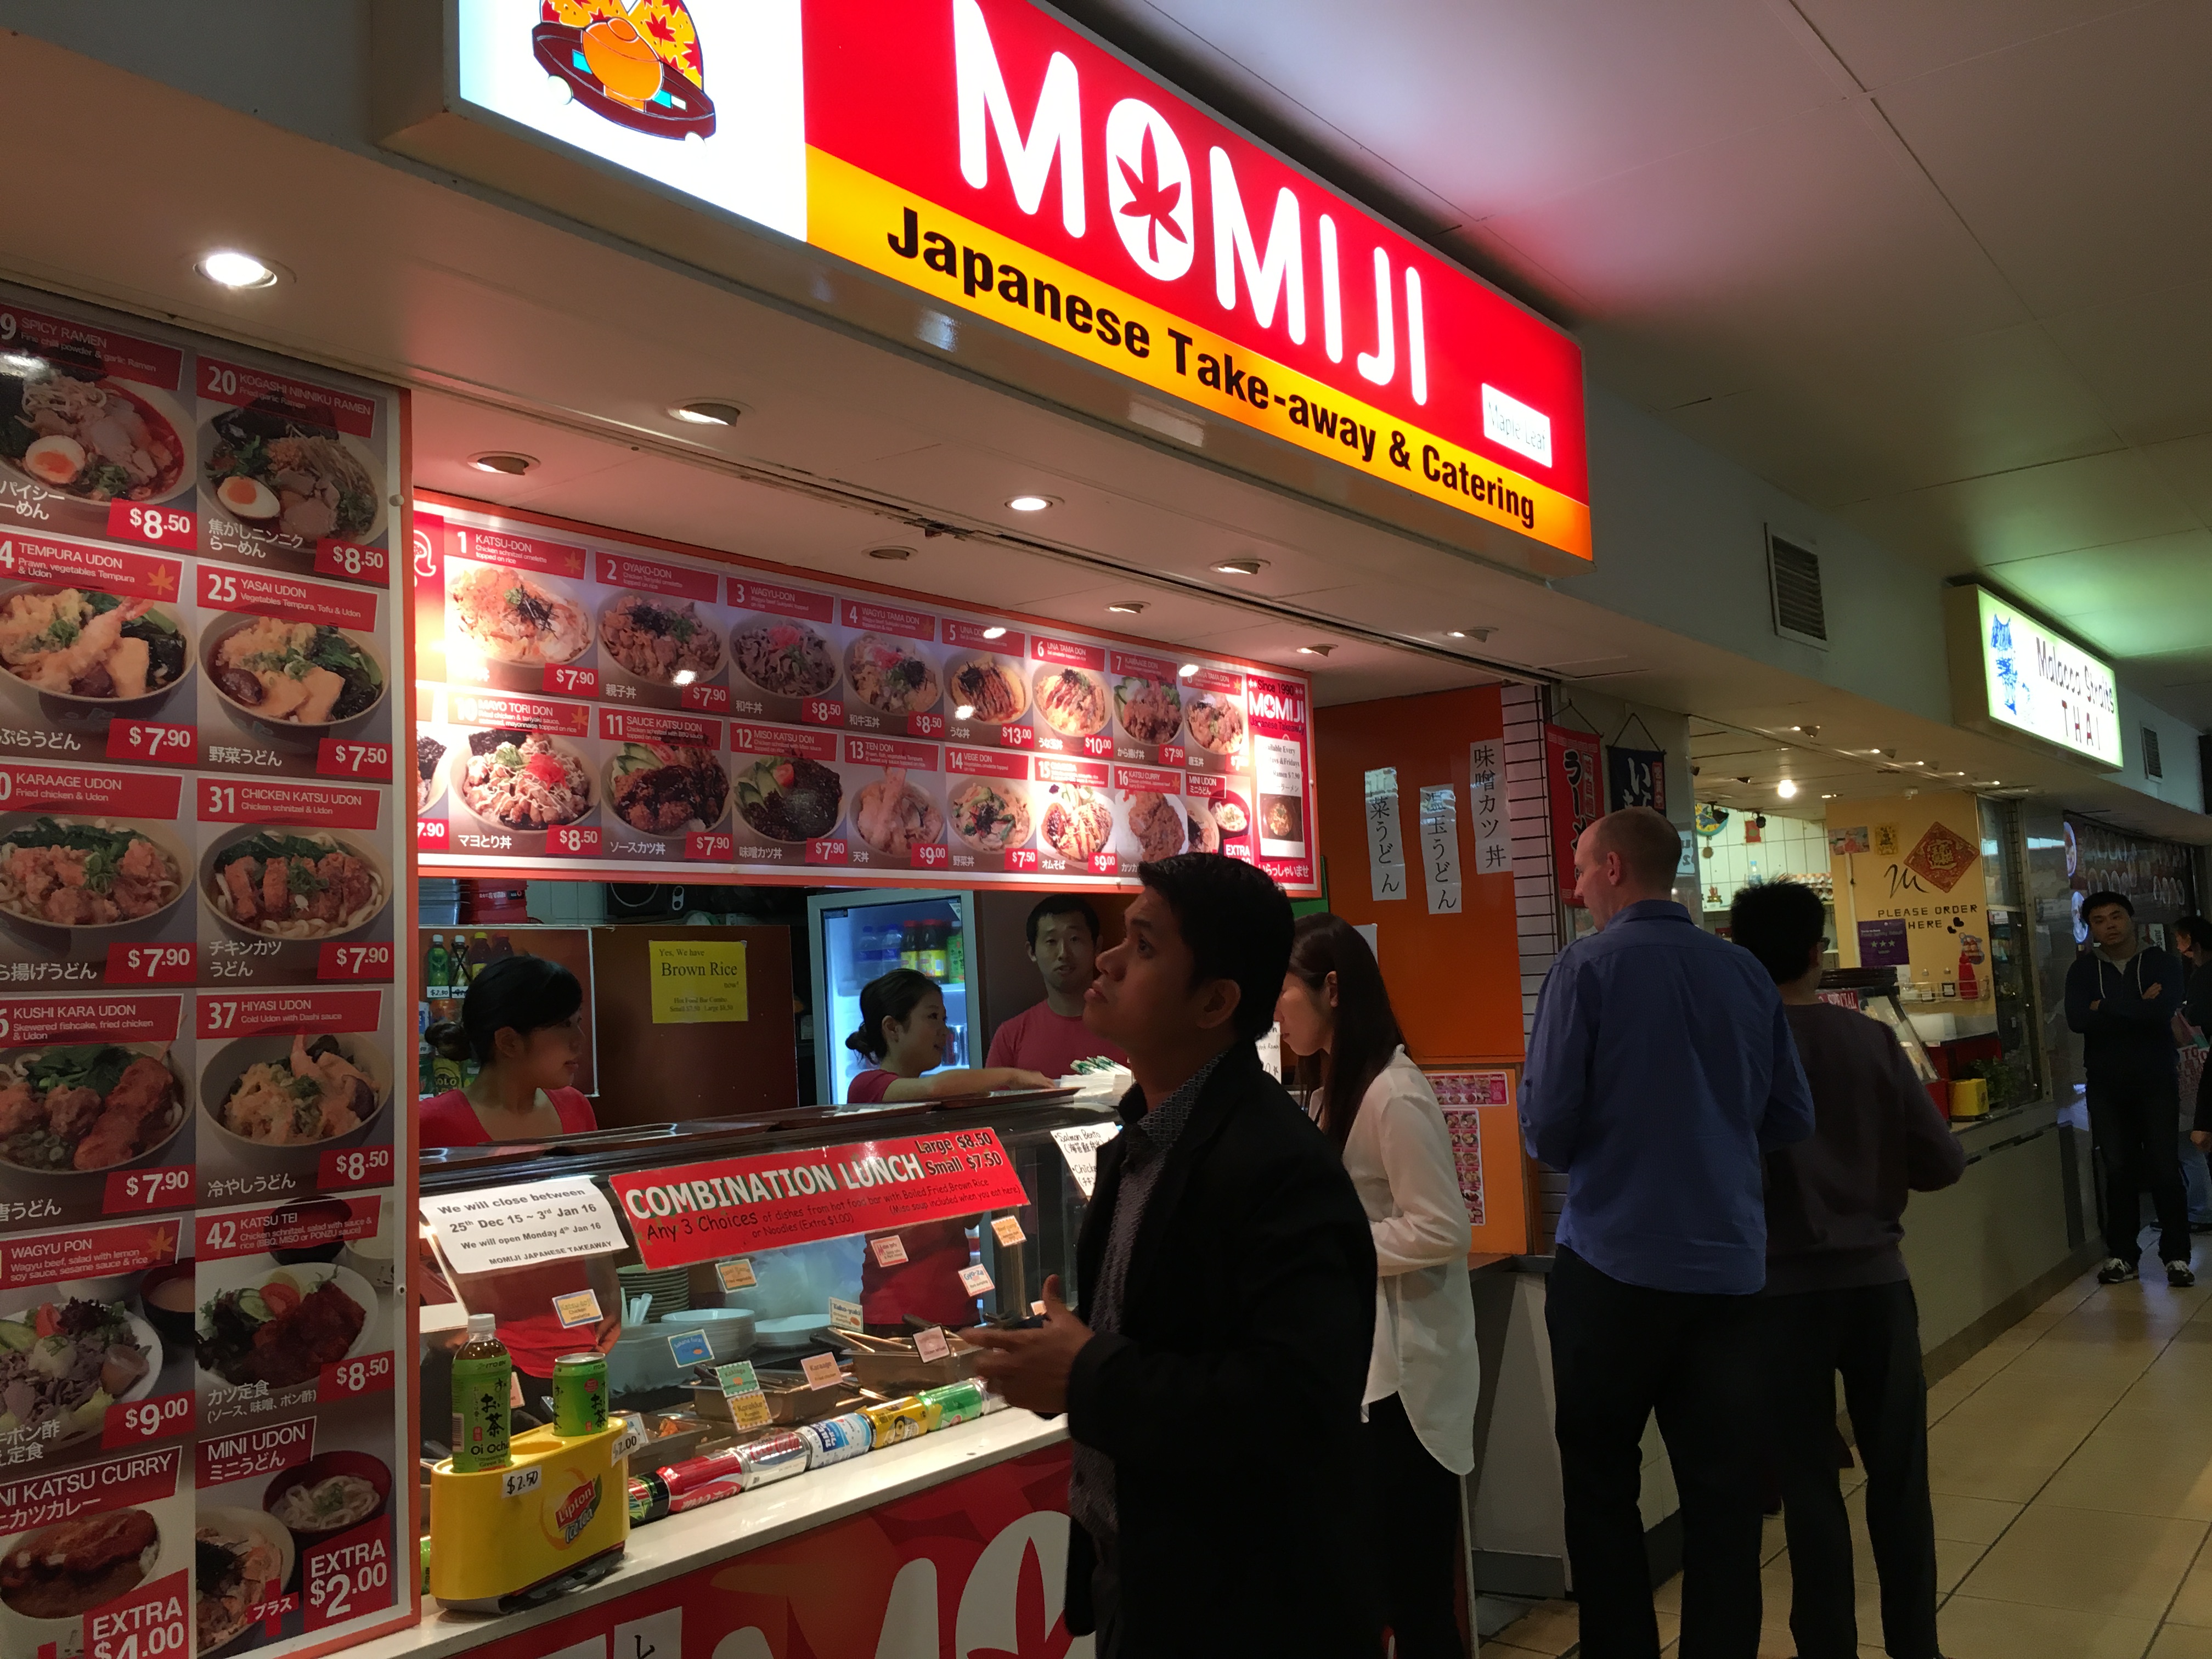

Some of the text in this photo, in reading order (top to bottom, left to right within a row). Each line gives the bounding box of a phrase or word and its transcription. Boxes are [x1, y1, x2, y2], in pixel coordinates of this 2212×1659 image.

[953, 0, 1427, 406] MOMIJI
[887, 205, 1536, 531] Japanese Take-away & Catering
[207, 366, 371, 416] 20 KOGASHI NINNIKU RAMEN
[129, 509, 190, 539] $8.50
[210, 537, 267, 558] らーめん
[458, 531, 532, 554] 1 KATSU-DON
[333, 547, 384, 574] $8.50
[607, 560, 672, 580] 2 OYAKO-DON
[208, 574, 307, 602] 25 YASAI UDON
[556, 668, 594, 690] $7.90
[1257, 679, 1294, 695] Since 1990
[693, 687, 726, 707] $7.90
[1249, 694, 1305, 724] MOMIJI
[812, 703, 840, 721] $8.50
[916, 716, 942, 733] $8.50
[1250, 716, 1277, 729] Japanese
[606, 715, 702, 735] 11 SAUCE KATSU DON
[1003, 726, 1031, 744] $13.00
[129, 726, 190, 755] $7.90
[1086, 738, 1111, 754] $10.00
[209, 747, 282, 768] 野菜うどん
[336, 746, 387, 771] $7.50
[1164, 747, 1183, 763] $7.90
[16, 772, 122, 791] KARAAGE UDON
[209, 786, 362, 813] 31 CHICKEN KATSU UDON
[1474, 744, 1507, 868] 味噌カツ丼
[458, 835, 512, 849] マヨとり丼
[560, 830, 597, 851] $8.50
[611, 842, 665, 855] ソースカツ丼
[697, 837, 729, 855] $7.90
[816, 842, 844, 860] $7.90
[920, 847, 946, 865] $9.00
[1013, 851, 1035, 868] $7.50
[1095, 855, 1115, 871] $9.00
[1878, 904, 1978, 918] PLEASE ORDER
[1908, 919, 1943, 930] HERE
[209, 940, 281, 957] チキンカツ
[336, 947, 388, 974] $7.90
[659, 949, 674, 957] Yes,
[128, 949, 190, 977] $7.90
[209, 960, 253, 977] うどん
[662, 961, 737, 977] Brown Rice
[14, 1005, 136, 1019] KUSHI KARA UDON
[207, 999, 311, 1030] 37 HIYASI UDON
[915, 1132, 993, 1155] Large $8.50
[336, 1149, 388, 1180] $8.50
[925, 1150, 1003, 1176] Small $7.50
[126, 1171, 189, 1203] $7.90
[208, 1173, 296, 1198] 冷やしうどん
[625, 1153, 926, 1220] COMBINATION LUNCH
[437, 1189, 585, 1215] We will close between
[646, 1224, 678, 1242] Any
[681, 1218, 693, 1234] 3
[698, 1212, 759, 1232] Choices
[763, 1214, 773, 1222] of
[775, 1208, 804, 1221] dishes
[807, 1204, 830, 1215] from
[831, 1199, 845, 1210] hot
[847, 1198, 867, 1208] food
[868, 1195, 882, 1206] bar
[884, 1191, 902, 1203] with
[973, 1178, 989, 1188] Rice
[449, 1203, 597, 1233] 25th Dec 15 3rd Jan 16
[206, 1213, 298, 1250] 42 KATSU TEI
[461, 1242, 477, 1250] We
[479, 1238, 496, 1246] will
[498, 1235, 521, 1245] open
[522, 1228, 558, 1240] Monday
[573, 1224, 589, 1233] Jan
[590, 1222, 601, 1231] 16
[752, 1229, 761, 1238] or
[763, 1224, 798, 1237] Noodles
[11, 1239, 92, 1259] WAGYU PON
[489, 1240, 612, 1265] MOMIJI JAPANESE TAKEAWAY
[336, 1358, 388, 1390] $8.50
[208, 1380, 269, 1407] カツ定食
[126, 1399, 188, 1436] $9.00
[208, 1424, 306, 1461] MINI UDON
[470, 1440, 510, 1455] Oi Ocha
[24, 1454, 172, 1503] KATSU CURRY
[209, 1452, 286, 1481] ミニうどん
[506, 1470, 539, 1495] $2.50
[558, 1485, 592, 1522] Lipton
[312, 1539, 386, 1578] EXTRA
[311, 1563, 387, 1618] $2.00
[93, 1597, 182, 1640] EXTRA
[253, 1599, 292, 1622] プラス
